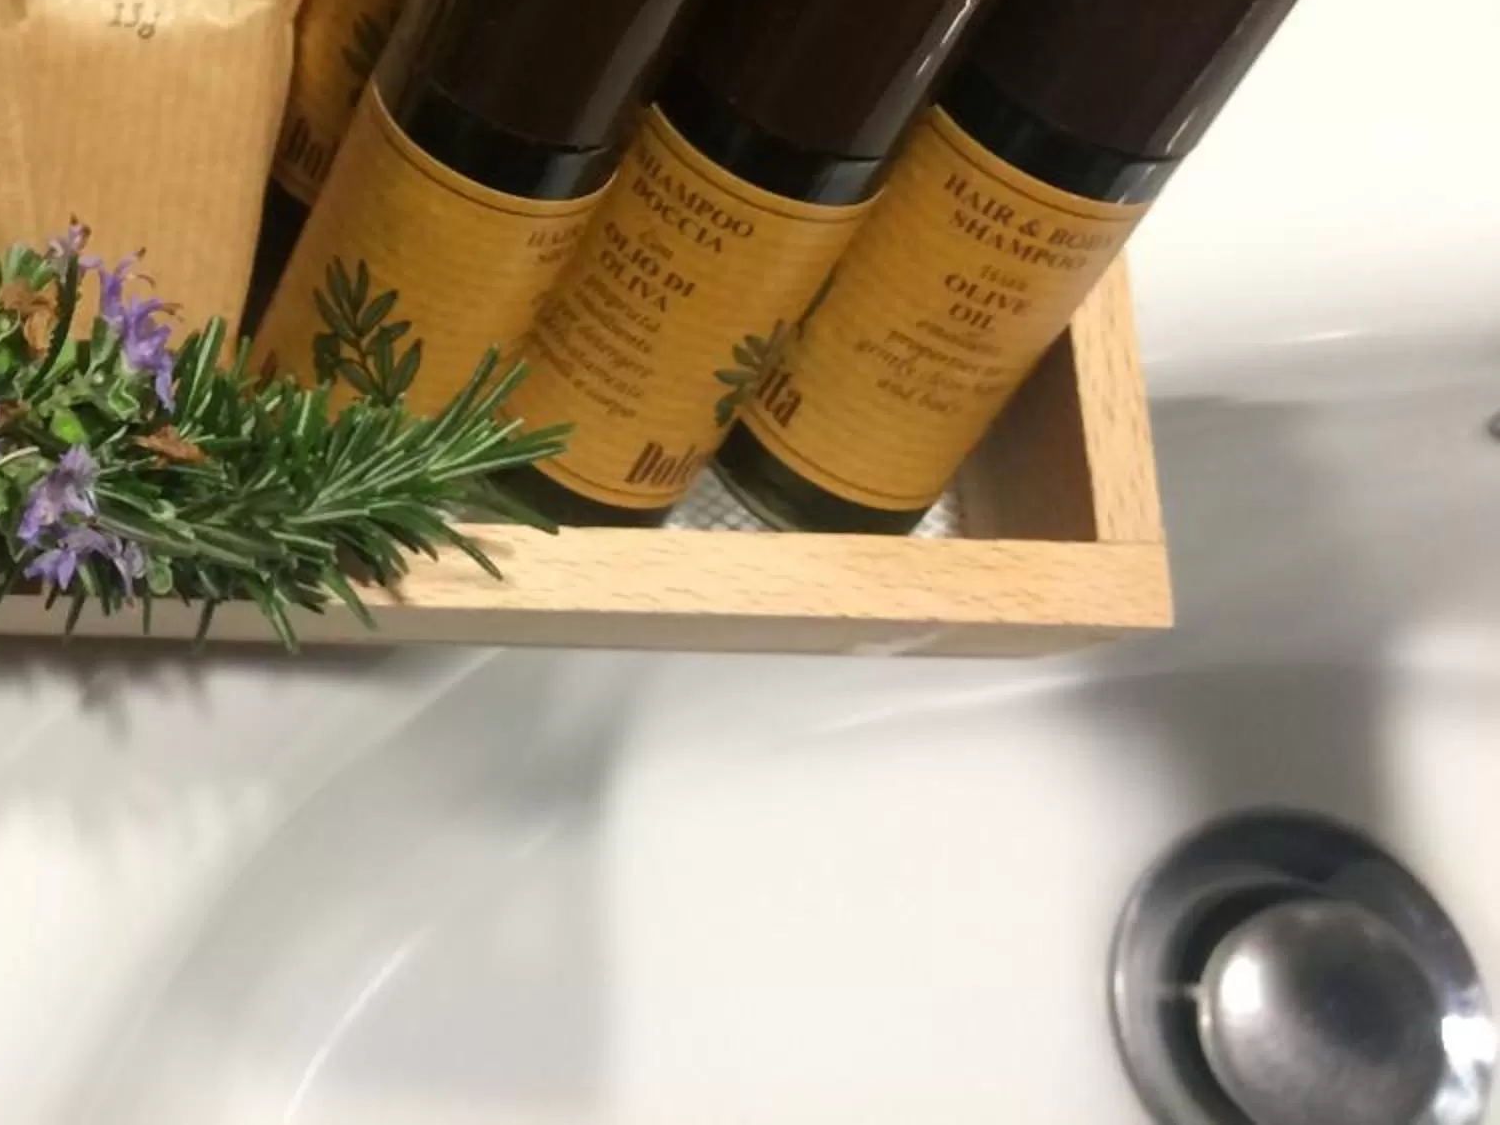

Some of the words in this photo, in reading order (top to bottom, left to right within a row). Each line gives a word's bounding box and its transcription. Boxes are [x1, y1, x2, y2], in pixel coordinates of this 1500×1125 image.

[632, 176, 722, 254] DOCCIA
[944, 172, 1016, 226] HAIR
[1018, 219, 1041, 238] &
[950, 208, 1089, 271] SHAMPOO
[600, 250, 668, 313] OLIVA
[664, 271, 697, 298] DI
[944, 272, 1033, 317] OLIVE
[948, 302, 997, 333] OIL
